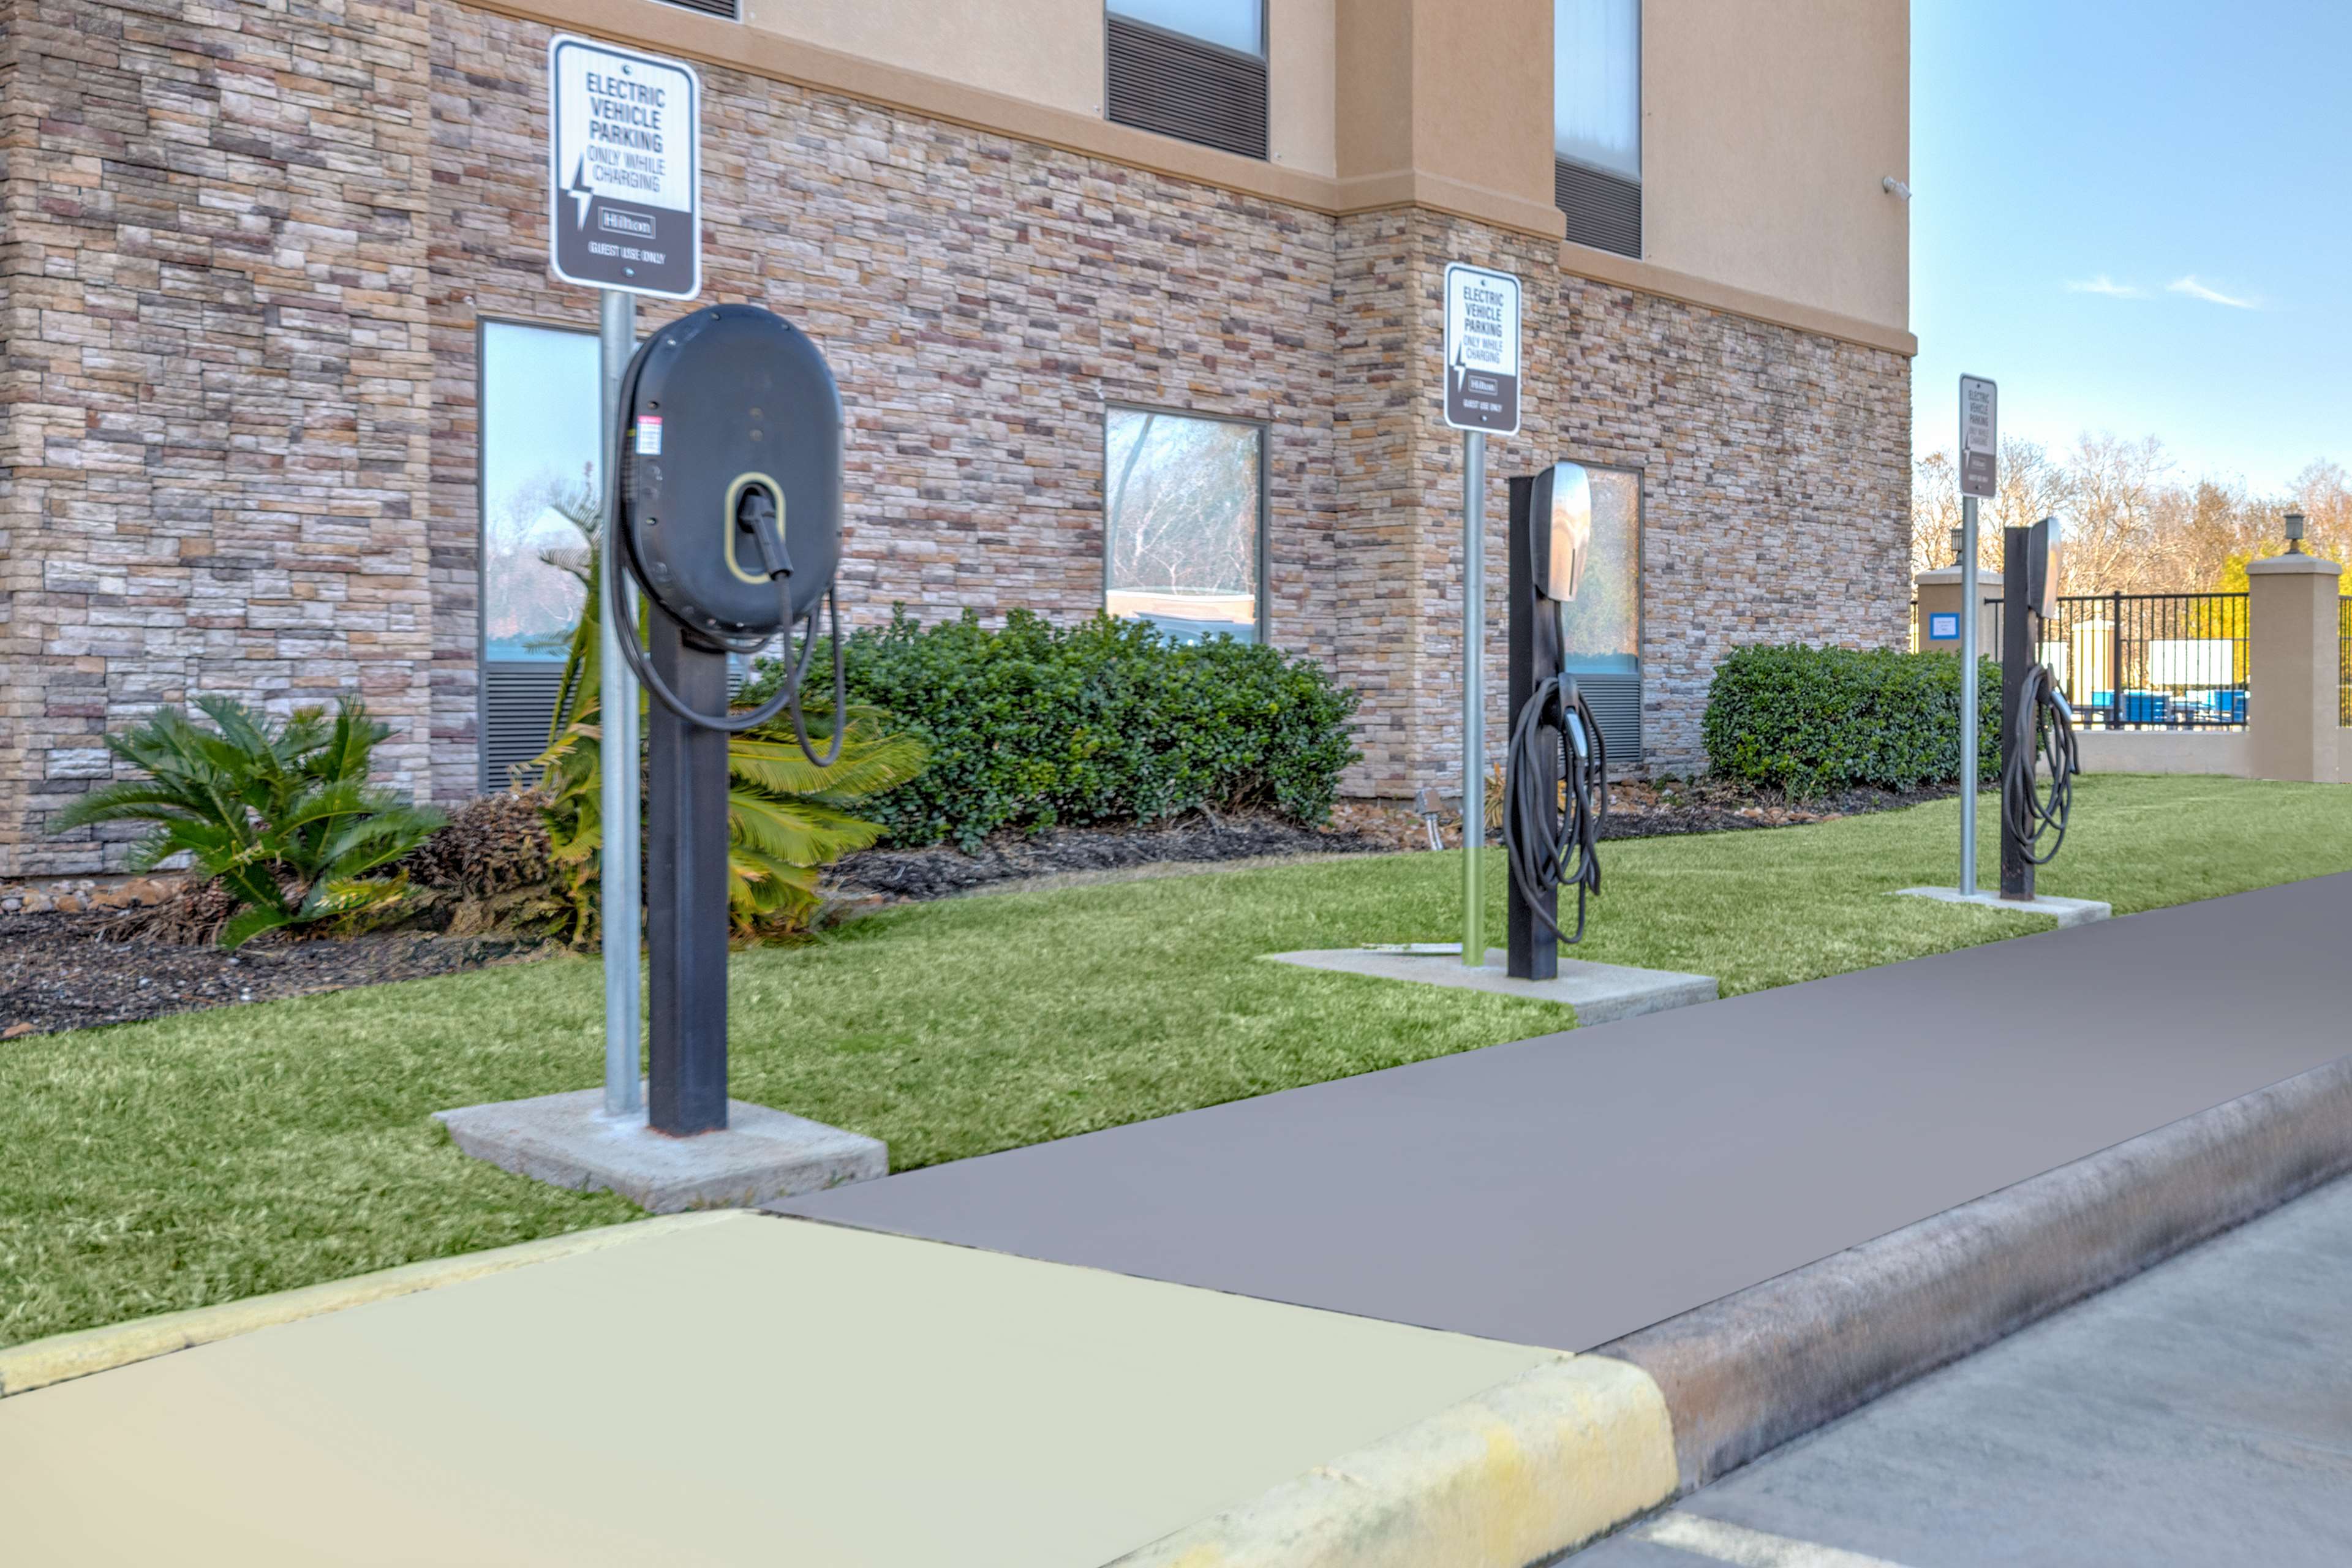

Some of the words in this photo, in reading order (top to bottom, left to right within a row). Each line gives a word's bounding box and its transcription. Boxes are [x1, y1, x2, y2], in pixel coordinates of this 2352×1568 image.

[587, 72, 666, 108] ELECTRIC
[589, 96, 662, 130] VEHICLE
[589, 119, 664, 154] PARKING
[586, 145, 621, 167] ONLY
[625, 153, 666, 176] WHILE
[592, 164, 661, 193] CHARGING
[603, 211, 651, 233] Hilton
[588, 241, 619, 257] GUEST
[620, 246, 641, 261] USE
[641, 250, 666, 265] ONLY
[1463, 286, 1504, 307] ELECTRIC
[1464, 303, 1501, 322] VEHICLE
[1464, 317, 1502, 337] PARKING
